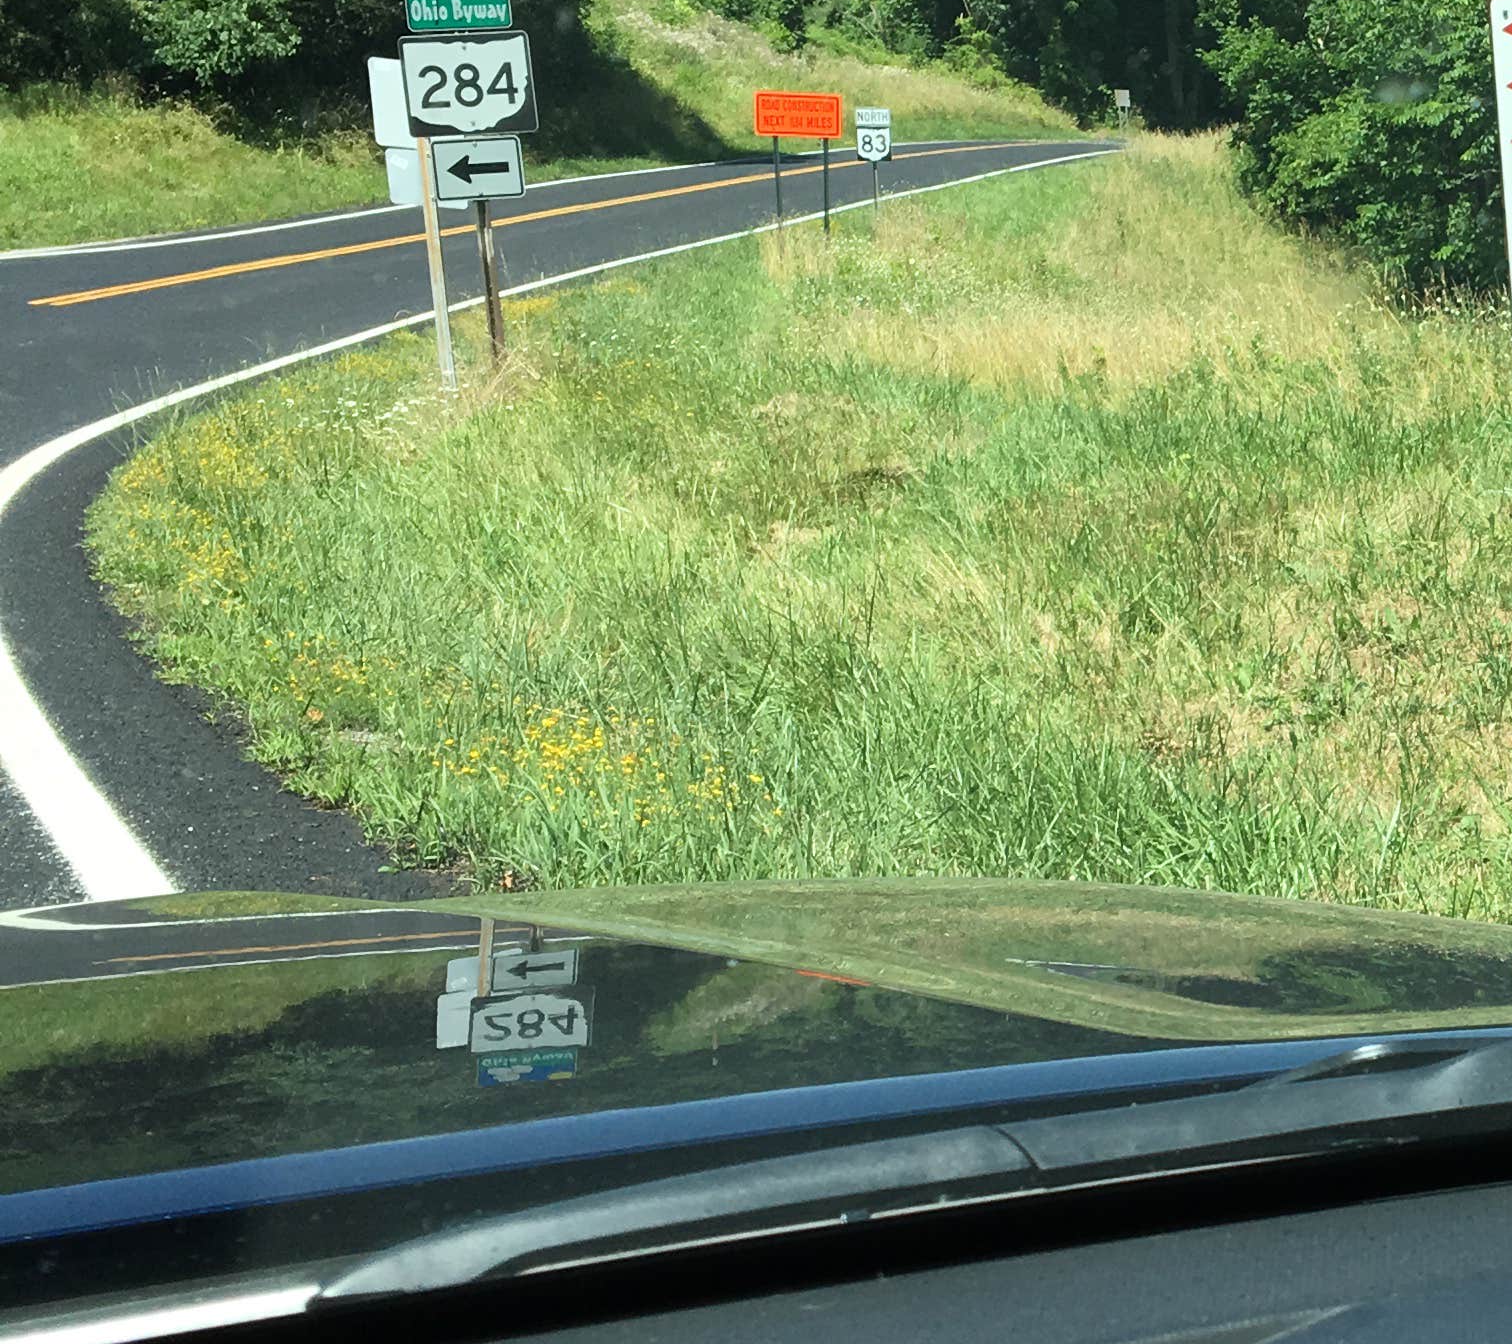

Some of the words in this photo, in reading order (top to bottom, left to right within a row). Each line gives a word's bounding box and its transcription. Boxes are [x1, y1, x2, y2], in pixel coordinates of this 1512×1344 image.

[410, 0, 448, 21] Ohio
[418, 61, 518, 109] 284
[763, 115, 785, 127] NEXT
[806, 116, 833, 129] MILES
[857, 110, 888, 121] NORTH
[861, 134, 887, 153] 83
